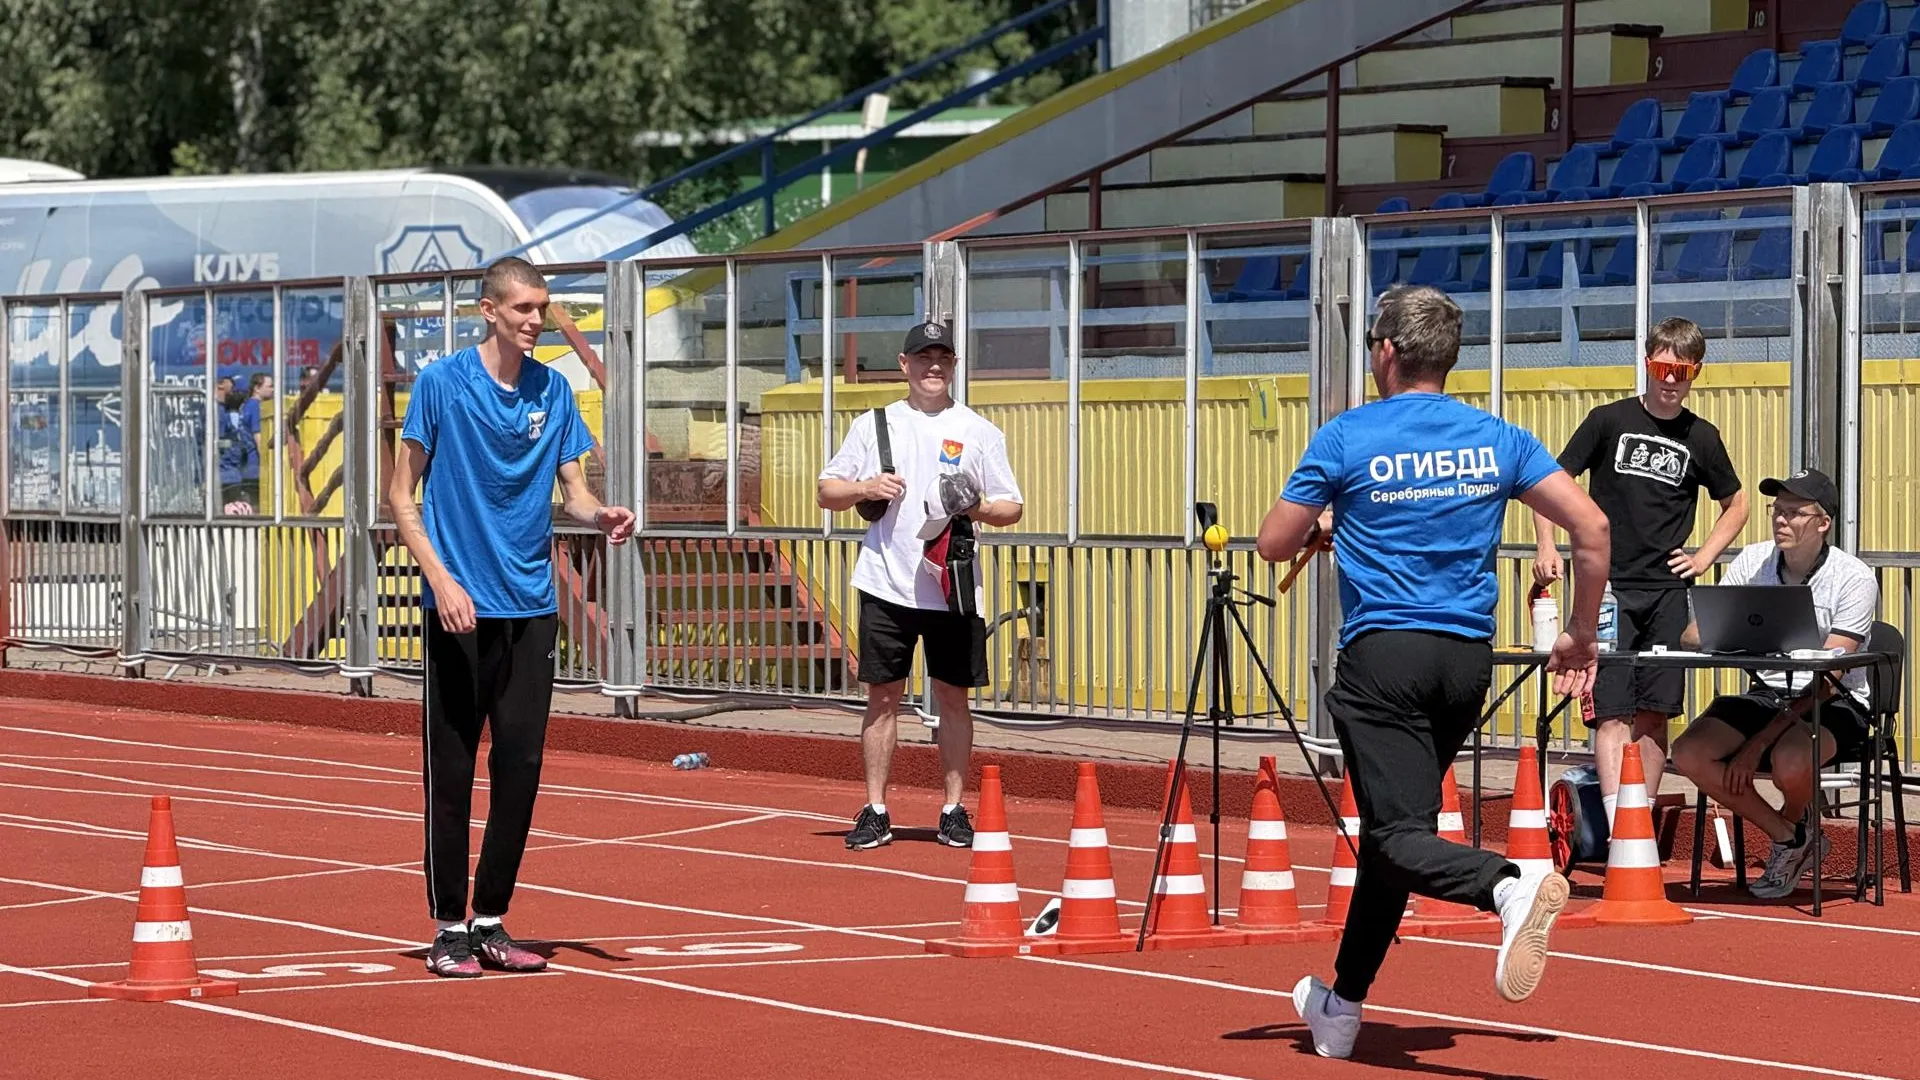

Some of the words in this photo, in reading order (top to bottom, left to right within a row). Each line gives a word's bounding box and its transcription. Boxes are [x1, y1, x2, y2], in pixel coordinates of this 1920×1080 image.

[1754, 10, 1765, 28] 10
[1655, 55, 1664, 78] 9
[1551, 107, 1560, 130] 8
[1448, 154, 1457, 177] 7
[193, 253, 280, 282] КЛУБ
[1369, 446, 1499, 482] ОГИБДД
[1370, 486, 1455, 504] Серебряные
[1458, 482, 1500, 497] Пруды
